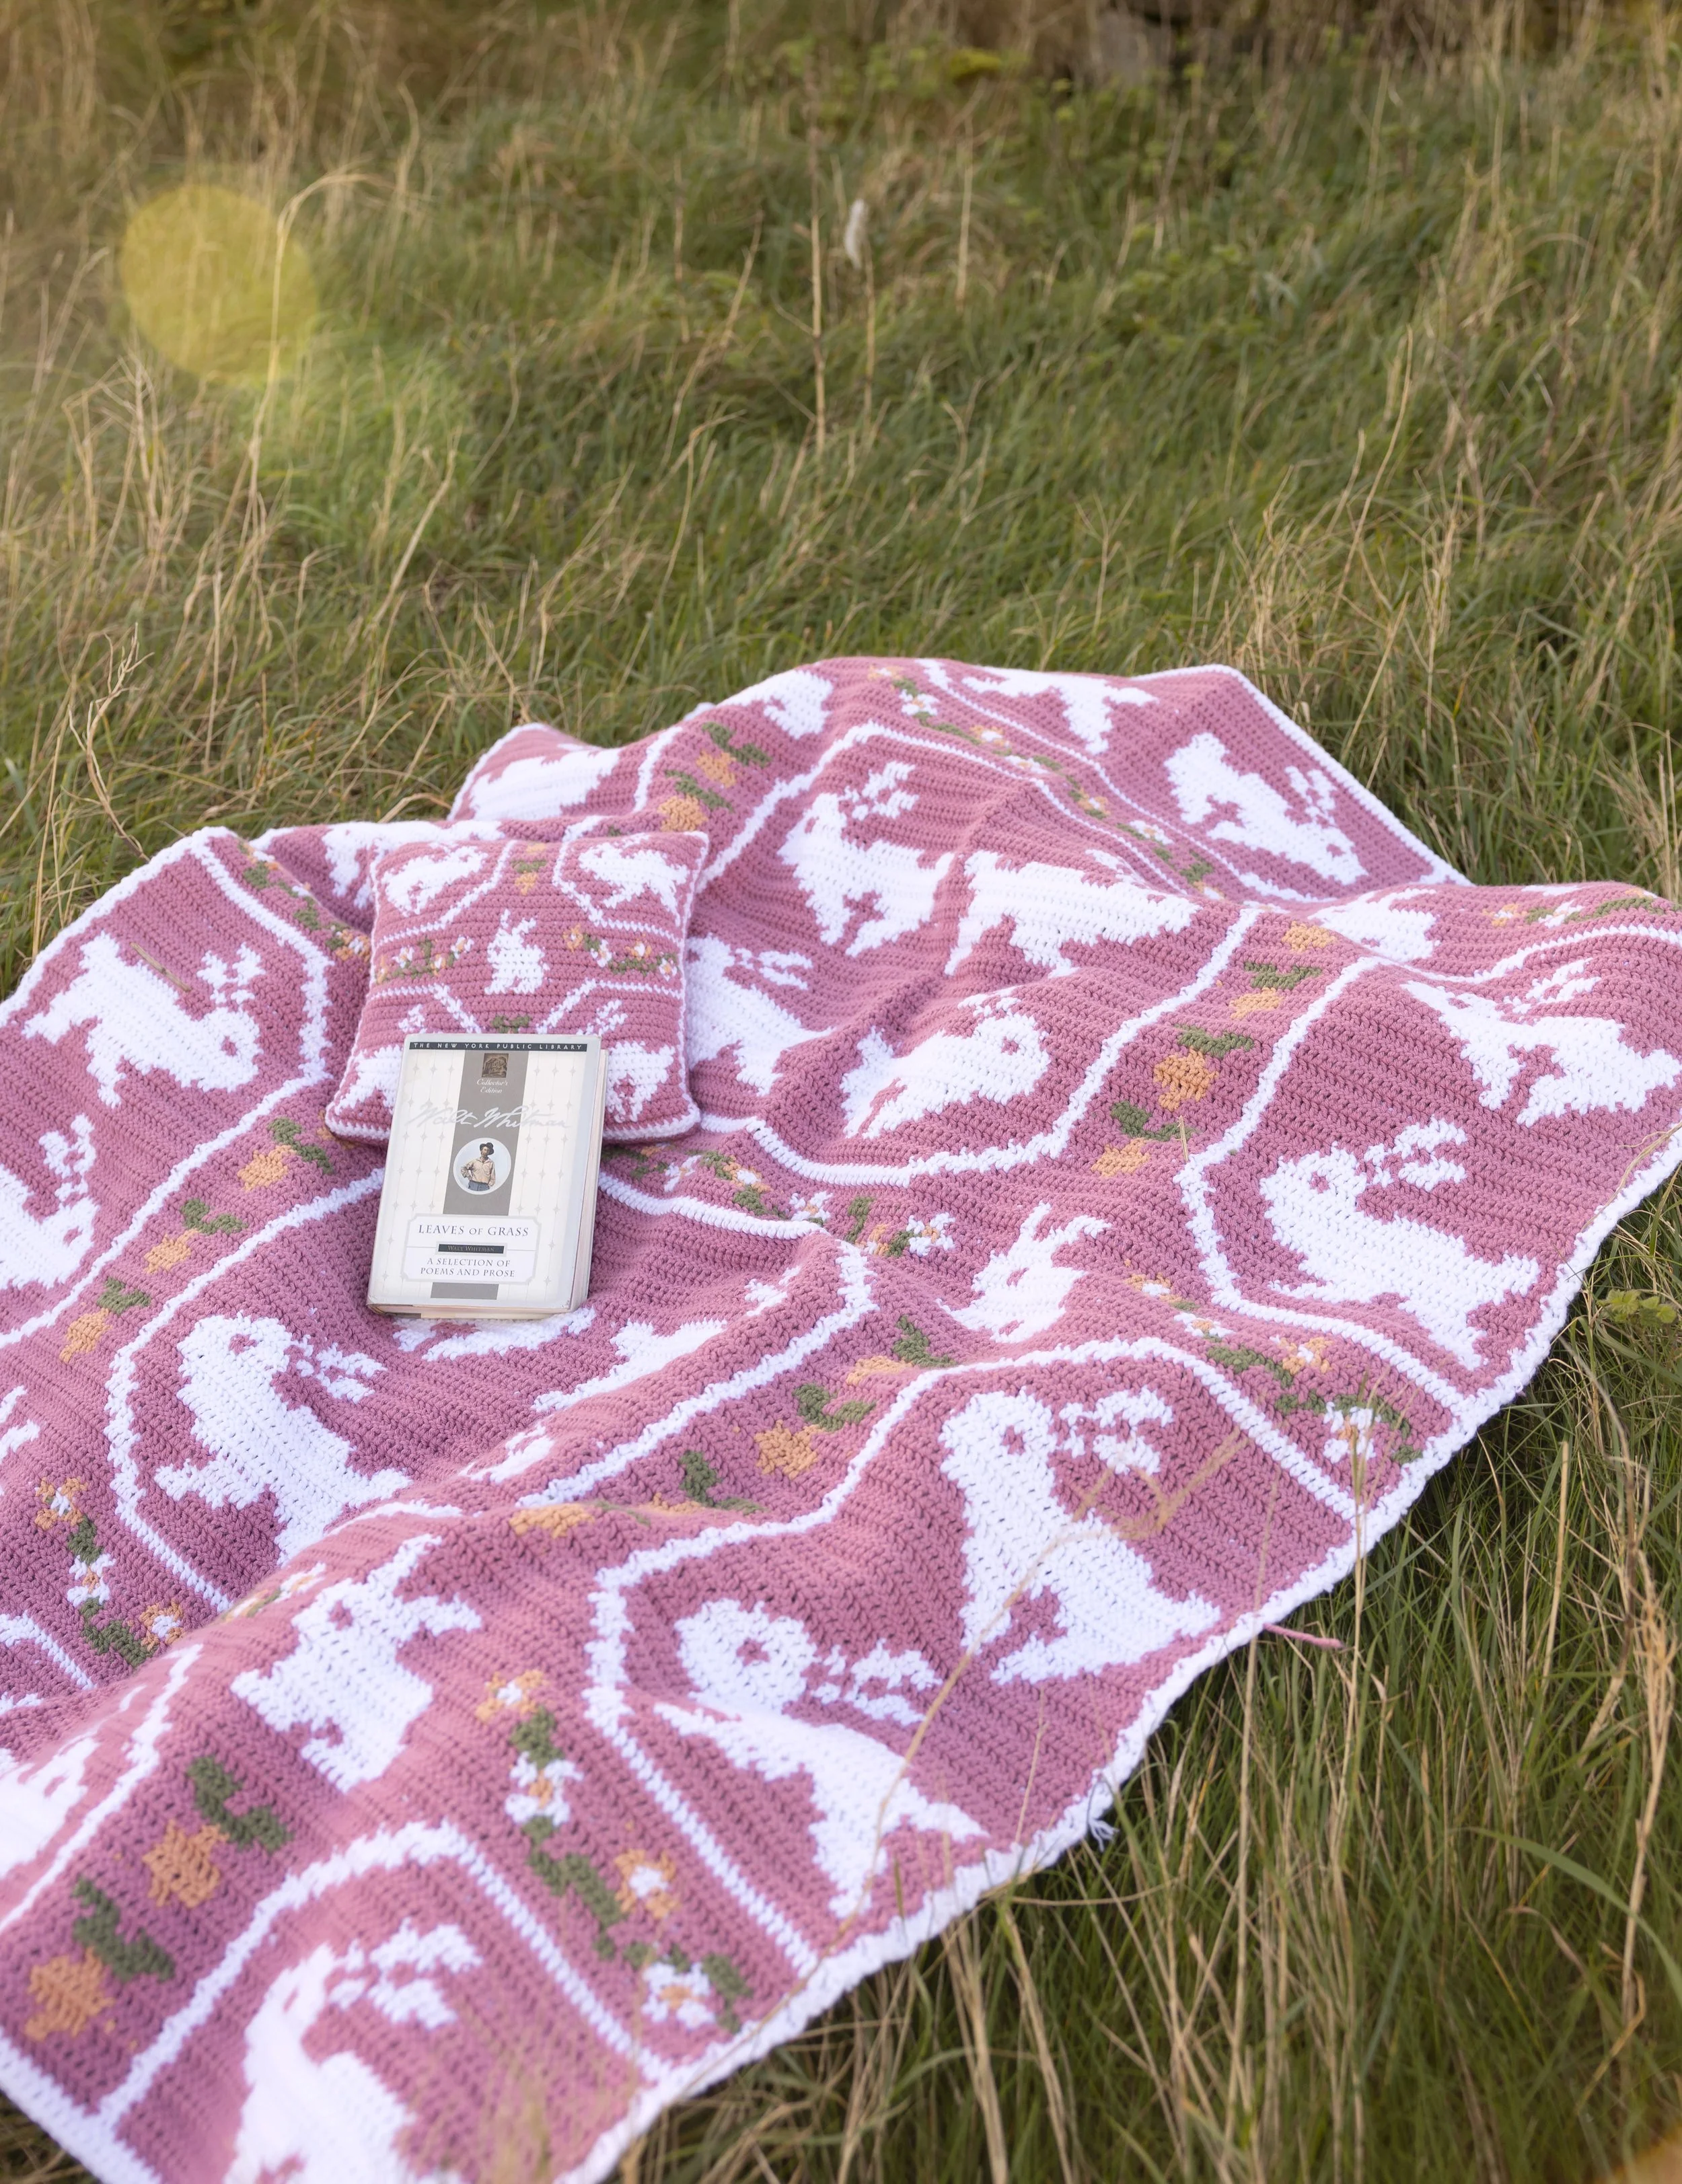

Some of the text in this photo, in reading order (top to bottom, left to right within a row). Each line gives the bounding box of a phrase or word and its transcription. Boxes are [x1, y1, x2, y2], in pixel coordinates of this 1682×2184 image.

[476, 1078, 508, 1087] Collector's
[480, 1086, 503, 1094] Edition
[418, 1225, 464, 1235] LEAVES
[488, 1227, 529, 1237] GRASS
[437, 1258, 493, 1266] SELECTION
